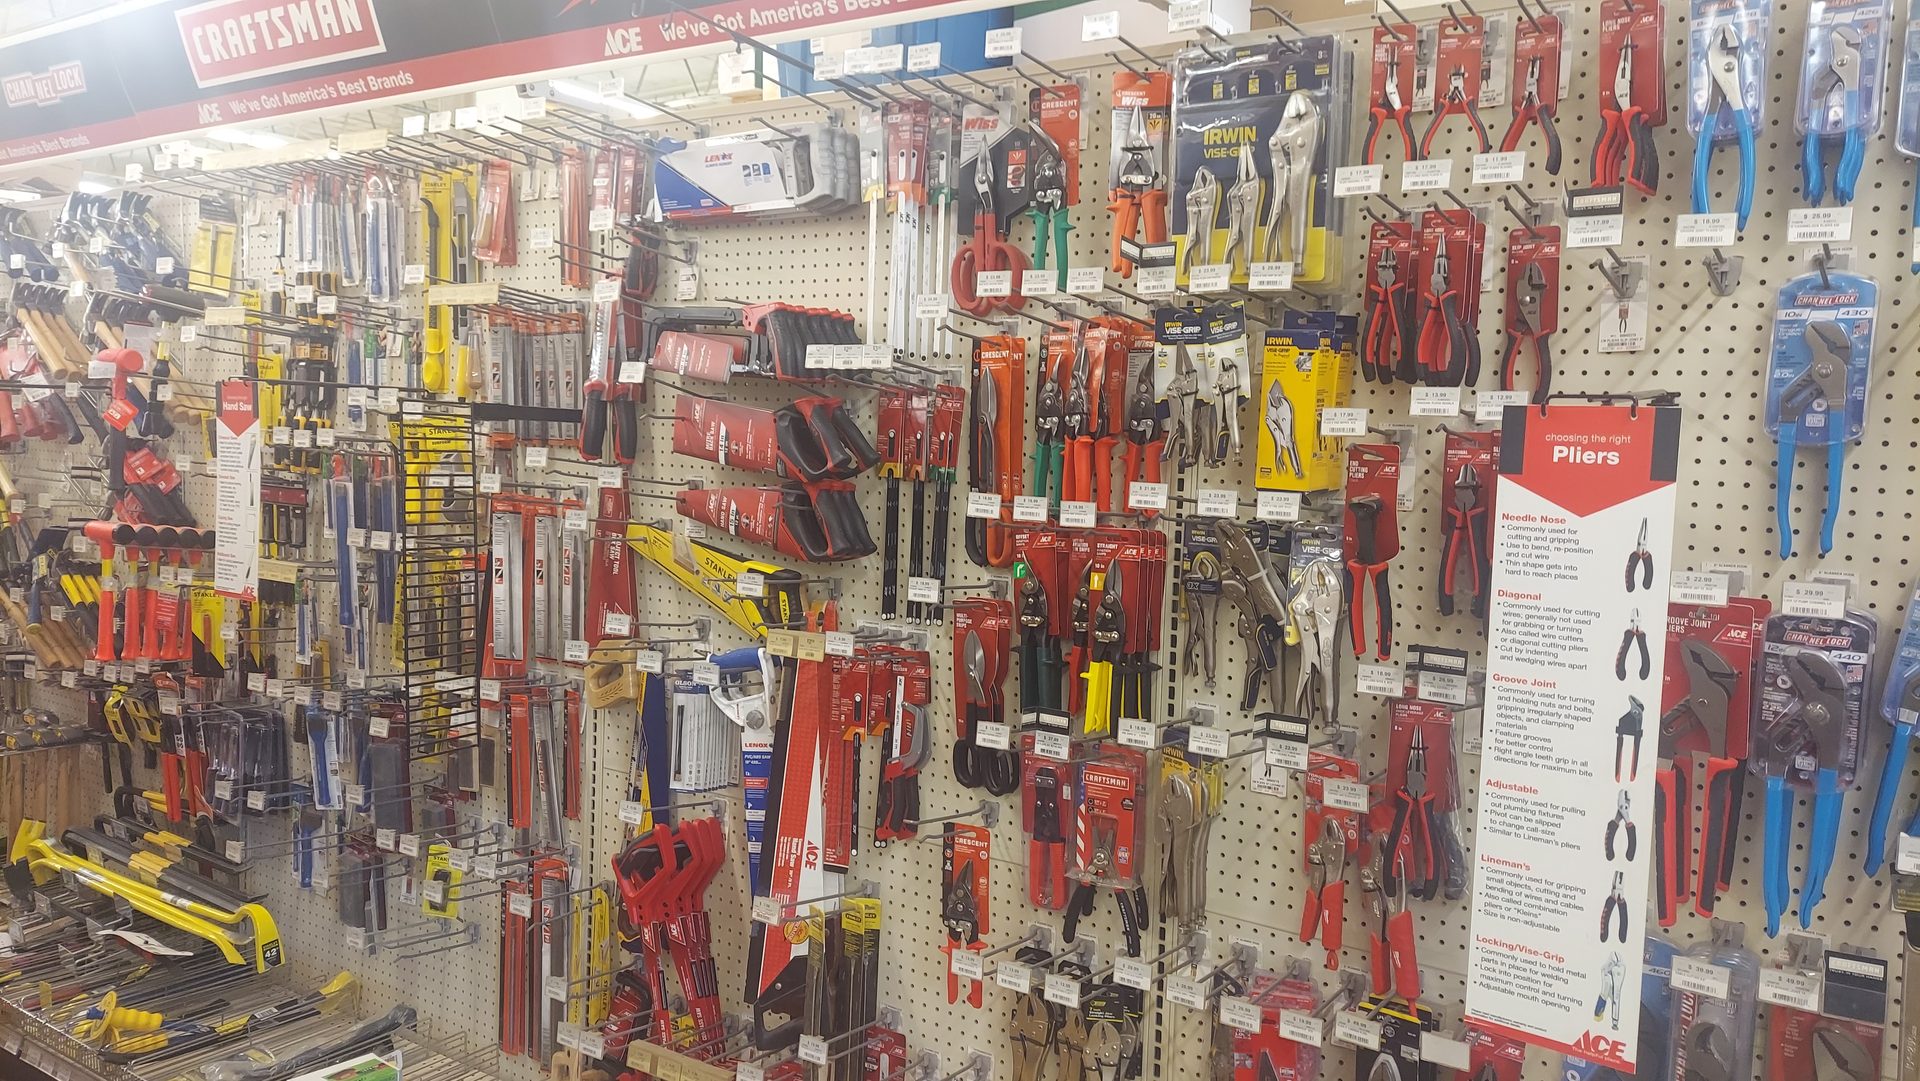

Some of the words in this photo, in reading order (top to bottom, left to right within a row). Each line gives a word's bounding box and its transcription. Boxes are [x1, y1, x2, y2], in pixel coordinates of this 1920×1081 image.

[1640, 15, 1654, 24] ACE
[191, 0, 363, 64] CRAFTSMAN
[604, 27, 643, 56] ACE
[658, 18, 710, 42] We've
[714, 14, 745, 34] Got
[750, 0, 838, 26] America's
[199, 103, 221, 124] ACE
[229, 96, 261, 115] We've
[262, 92, 281, 110] Got
[283, 86, 336, 107] America's
[340, 79, 365, 97] Best
[368, 70, 414, 90] Brands
[1041, 99, 1078, 109] CRESCENT
[1204, 126, 1256, 145] IRWIN
[1796, 296, 1856, 306] CHANNELLOCK
[1166, 326, 1201, 334] VISE-GRIP
[1210, 322, 1238, 334] VISE-GRIP
[1266, 336, 1293, 346] IRWIN
[981, 350, 1010, 358] CRESCENT
[222, 402, 238, 411] Hand
[239, 402, 252, 412] Saw
[1546, 433, 1588, 444] choosing
[1591, 434, 1606, 442] the
[1609, 435, 1631, 444] right
[1553, 446, 1620, 465] Pliers
[1502, 513, 1537, 522] Needle
[1540, 515, 1566, 524] Nose
[1507, 524, 1545, 534] Commonly
[1040, 535, 1052, 543] ACE
[1507, 534, 1531, 542] cutting
[1549, 537, 1579, 545] gripping
[1124, 548, 1138, 556] ACE
[1532, 544, 1551, 552] bend,
[1554, 545, 1593, 554] re-position
[1498, 590, 1541, 600] Diagonal
[1690, 618, 1712, 628] JOINT
[1727, 629, 1748, 638] ACE
[1786, 632, 1849, 646] CHANNELLOCK
[1832, 653, 1862, 662] 440
[1492, 674, 1528, 685] Groove
[1531, 678, 1557, 689] Joint
[1164, 746, 1184, 760] IRWIN
[1085, 773, 1126, 787] CRAFTSMAN
[1486, 779, 1539, 795] Adjustable
[955, 836, 988, 848] CRESCENT
[805, 840, 820, 870] ACE
[1481, 854, 1531, 871] Lineman's
[1476, 934, 1565, 964] Locking/Vise-Grip
[1481, 947, 1519, 961] Commonly
[1520, 957, 1538, 967] used
[1548, 964, 1564, 974] hold
[1566, 968, 1586, 979] metal
[1480, 964, 1497, 974] Lock
[1499, 968, 1512, 978] into
[1513, 972, 1541, 986] position
[1543, 980, 1553, 988] for
[1481, 957, 1499, 966] parts
[1508, 962, 1527, 974] place
[1541, 971, 1569, 984] welding
[1480, 973, 1514, 987] maximum
[1516, 982, 1540, 994] control
[1542, 989, 1556, 998] and
[1557, 993, 1583, 1007] turning
[1478, 981, 1515, 996] Adjustable
[1517, 990, 1540, 1003] mouth
[1541, 998, 1570, 1012] opening
[1572, 1030, 1627, 1059] ACE
[1506, 1047, 1520, 1056] ACE
